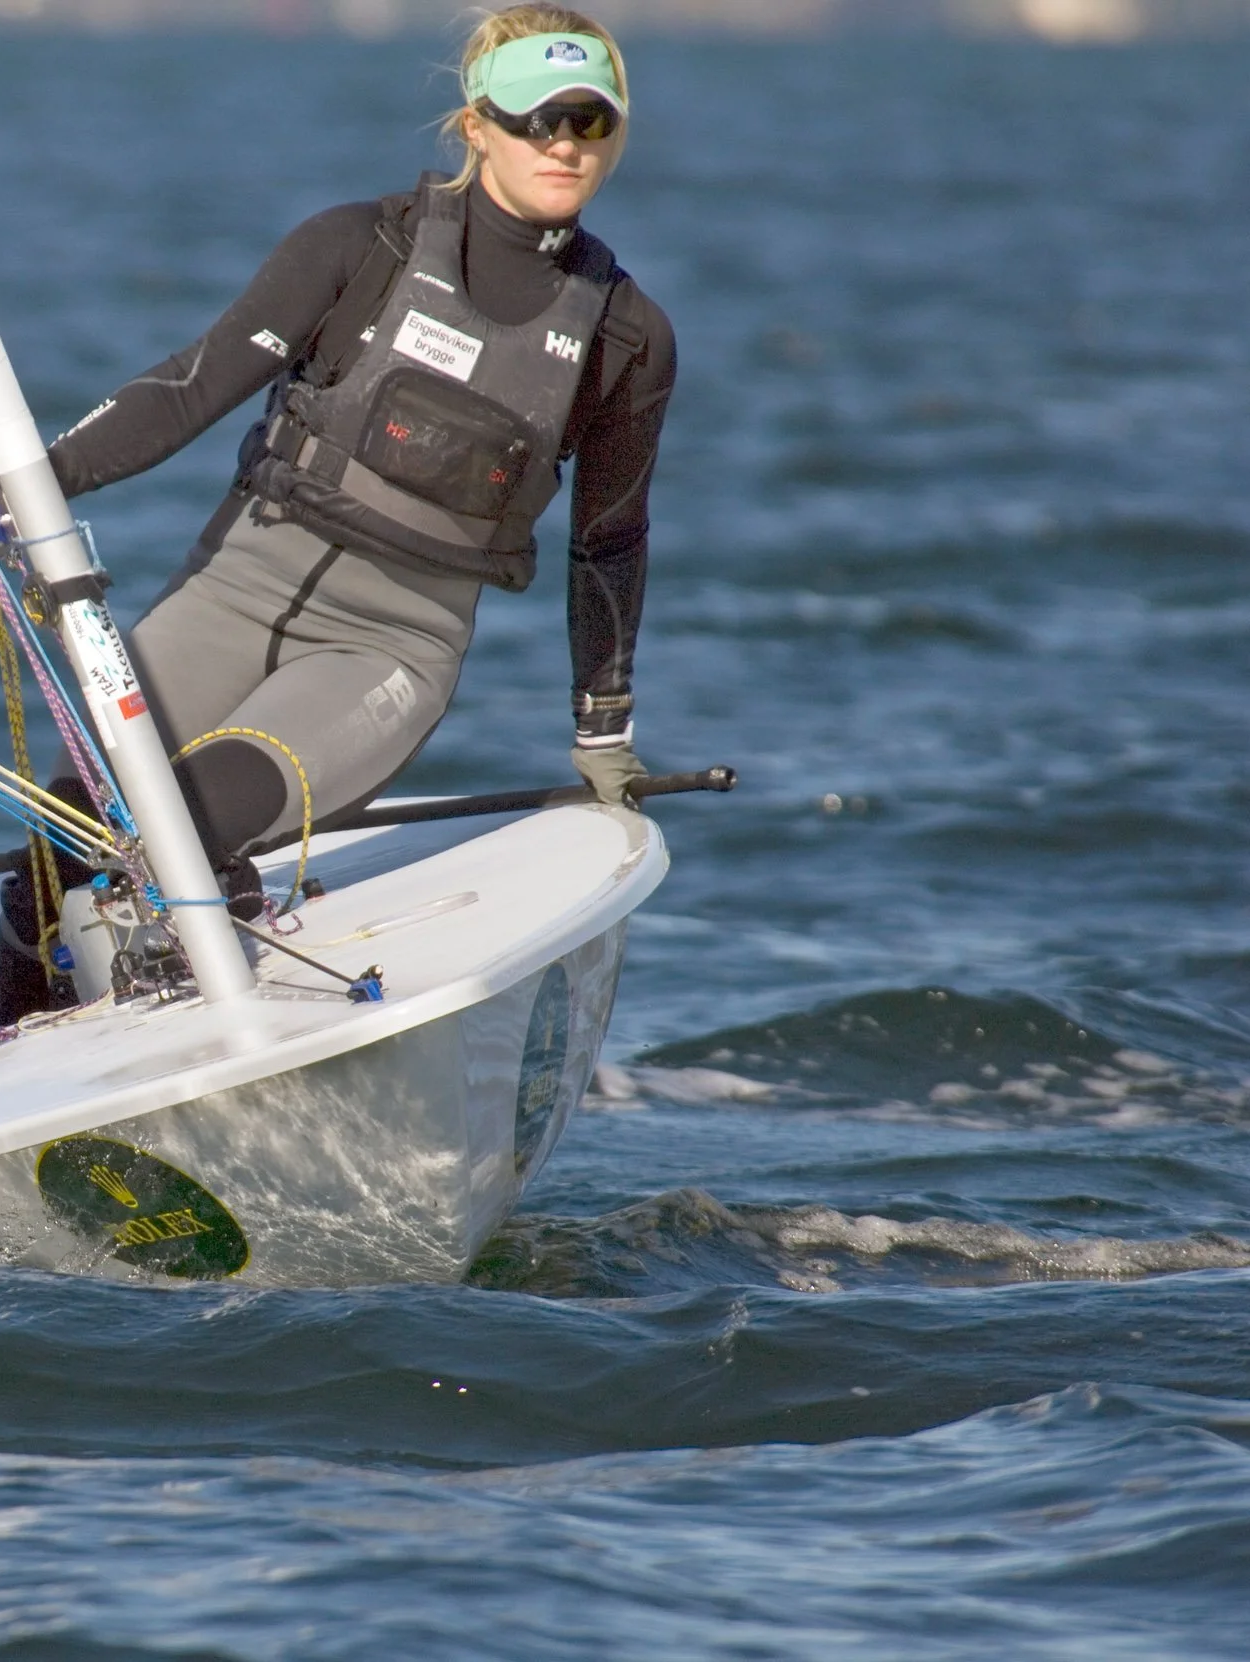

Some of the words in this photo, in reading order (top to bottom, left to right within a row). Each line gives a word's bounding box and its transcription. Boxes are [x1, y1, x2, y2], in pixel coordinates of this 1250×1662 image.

[406, 315, 477, 356] Engelsviken
[414, 337, 456, 365] brygge
[544, 329, 583, 364] HH
[90, 666, 117, 698] TEAM
